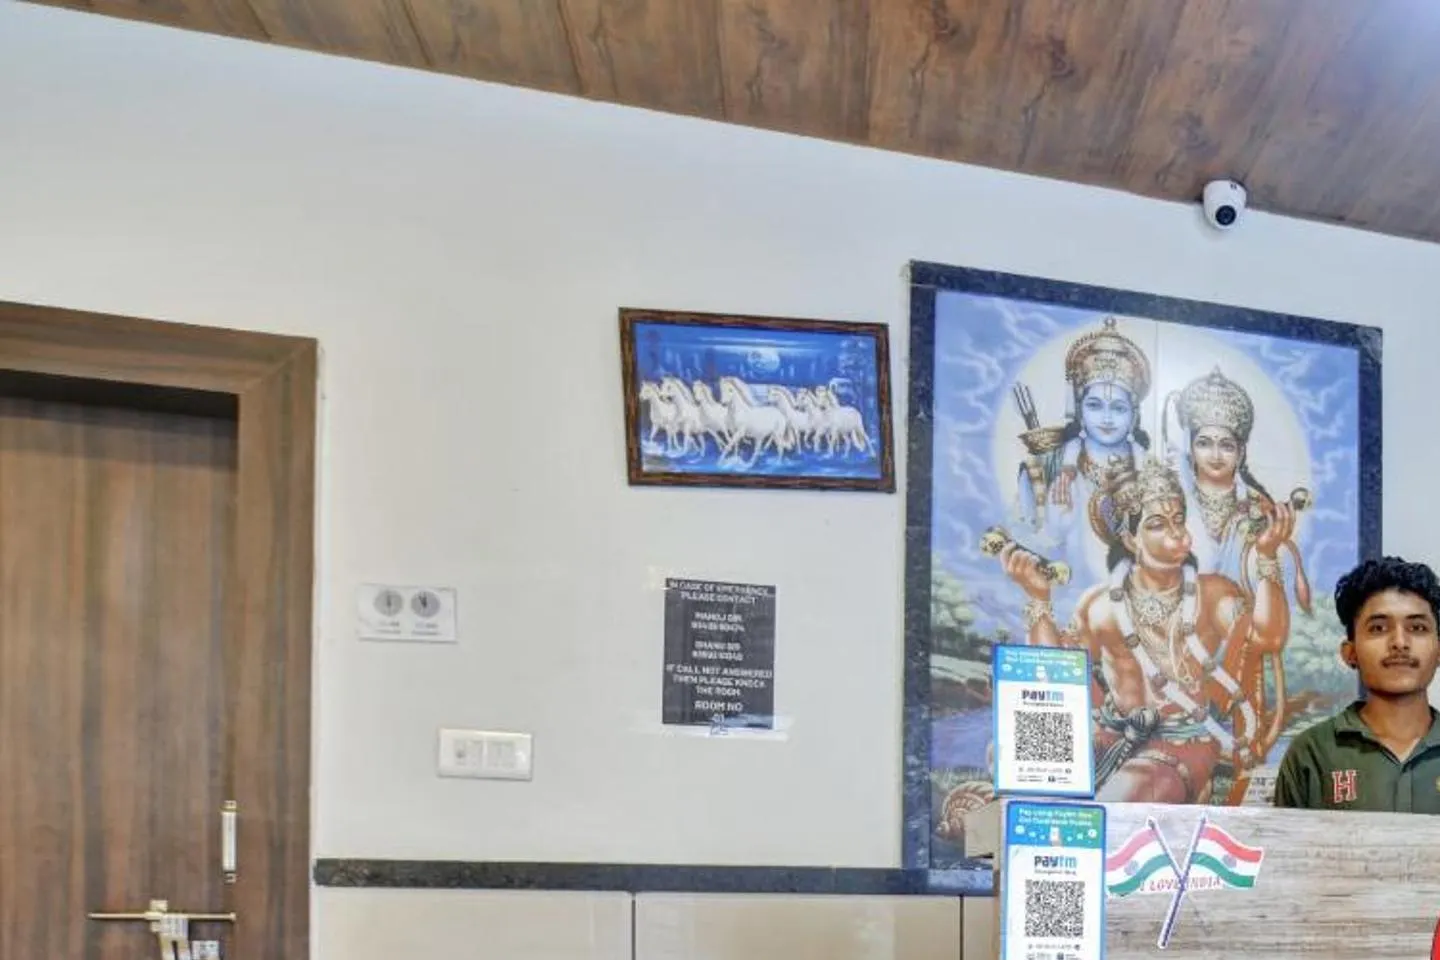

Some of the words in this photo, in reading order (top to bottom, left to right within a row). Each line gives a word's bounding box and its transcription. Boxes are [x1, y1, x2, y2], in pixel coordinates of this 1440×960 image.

[681, 591, 715, 601] PLEASE
[694, 700, 725, 712] ROOM
[727, 702, 744, 712] NO
[1331, 769, 1358, 804] H
